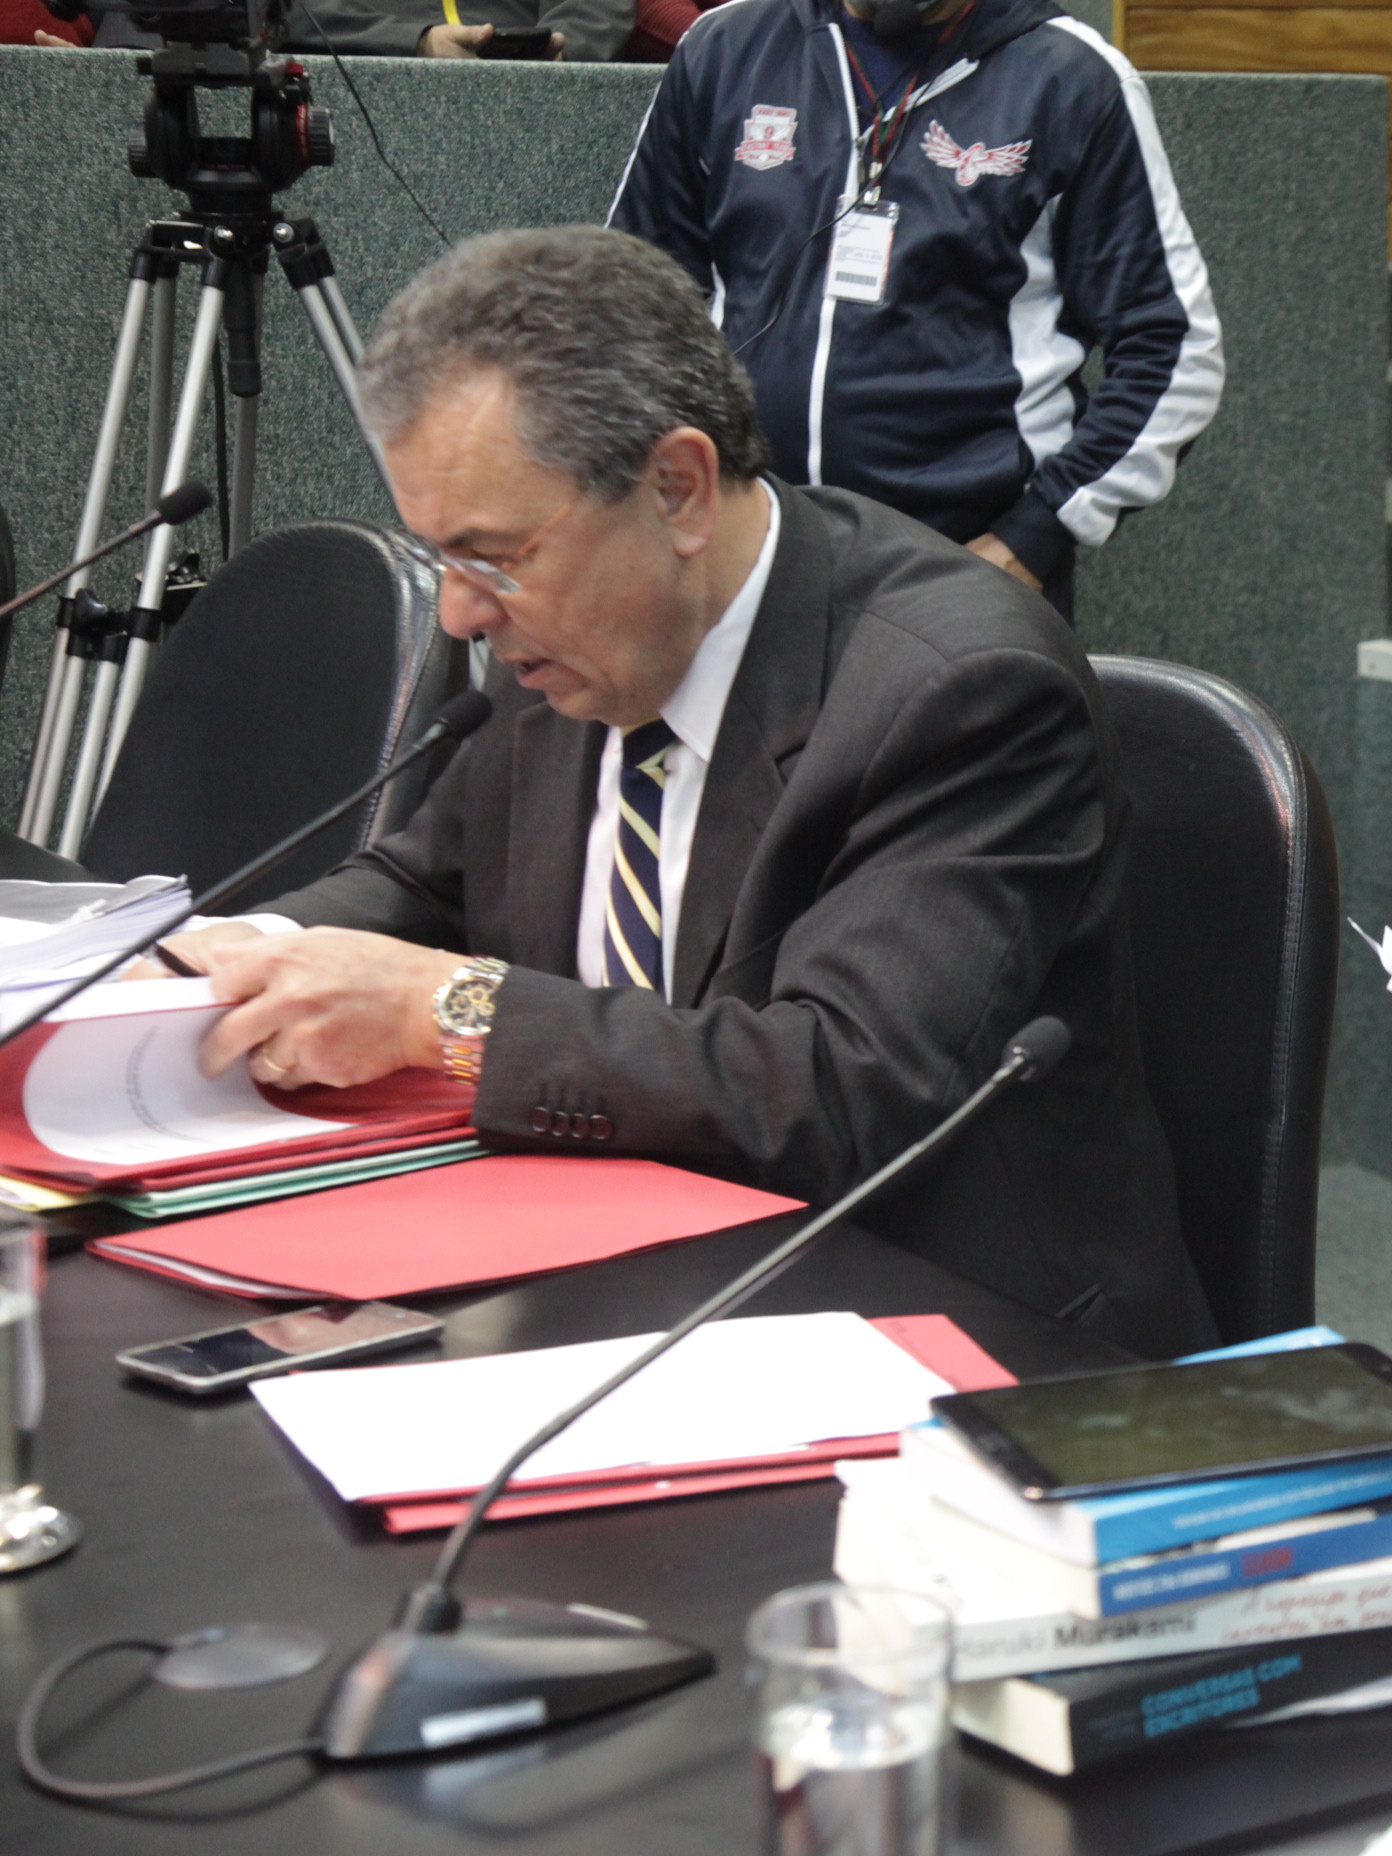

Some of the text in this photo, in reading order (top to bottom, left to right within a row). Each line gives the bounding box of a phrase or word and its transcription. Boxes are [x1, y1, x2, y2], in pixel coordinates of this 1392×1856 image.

[1054, 1612, 1197, 1649] Murakami
[1140, 1654, 1302, 1716] CONVERSAS COM
[1142, 1687, 1261, 1738] ESCRITORES
